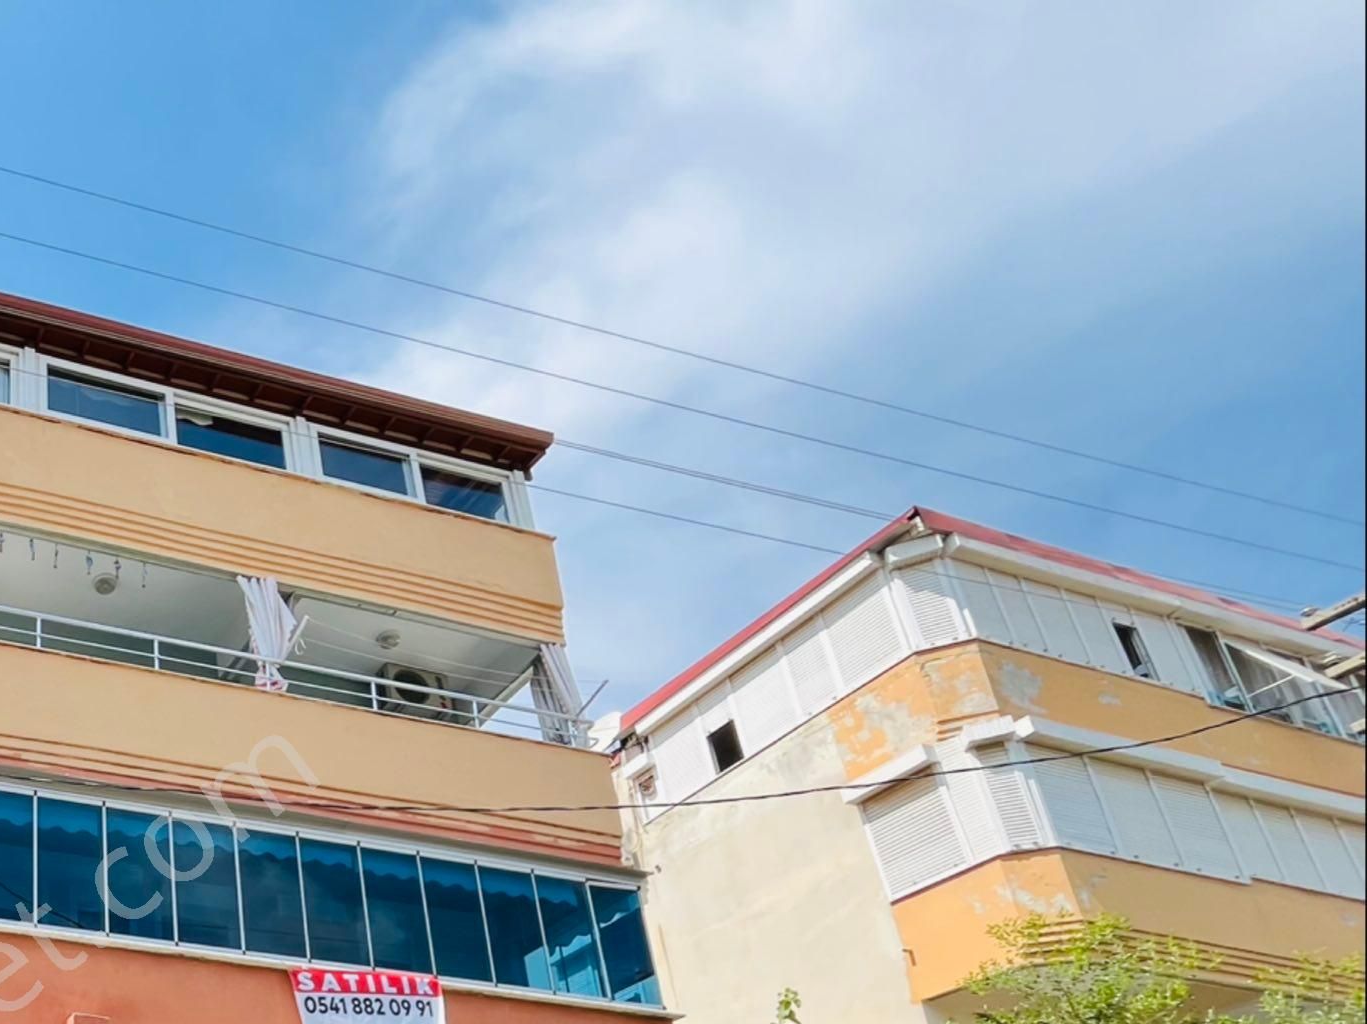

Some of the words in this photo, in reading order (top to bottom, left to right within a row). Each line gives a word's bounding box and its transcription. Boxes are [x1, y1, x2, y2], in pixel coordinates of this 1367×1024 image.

[297, 972, 434, 995] SATILIK
[304, 996, 347, 1014] 0541
[352, 998, 386, 1016] 882
[389, 999, 411, 1016] 09
[415, 1000, 434, 1017] 91
